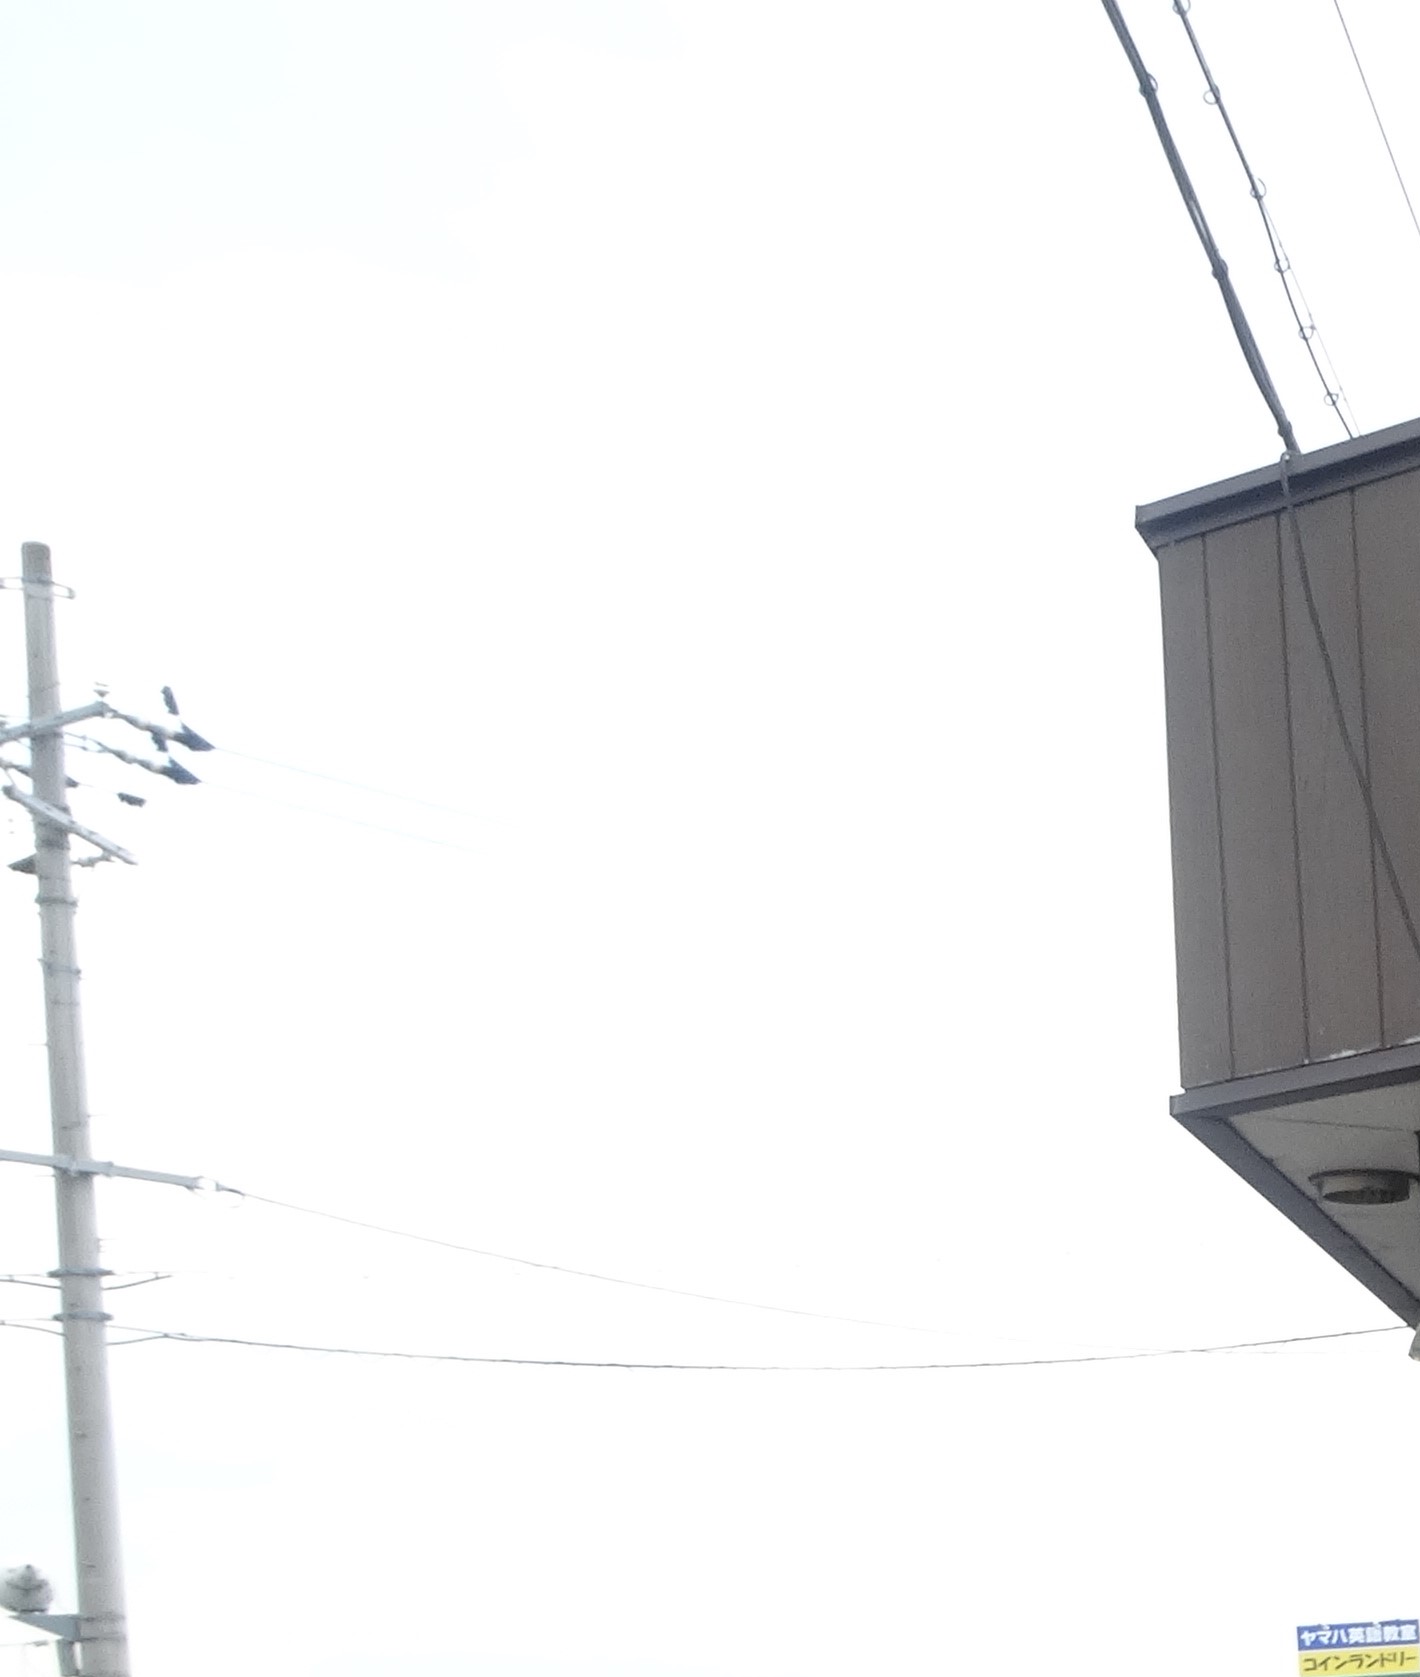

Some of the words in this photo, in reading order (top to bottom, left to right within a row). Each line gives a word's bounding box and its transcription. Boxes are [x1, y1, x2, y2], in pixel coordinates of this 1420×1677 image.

[1301, 1625, 1417, 1646] ヤマハ英語教室
[1304, 1651, 1416, 1671] コインランドリー
